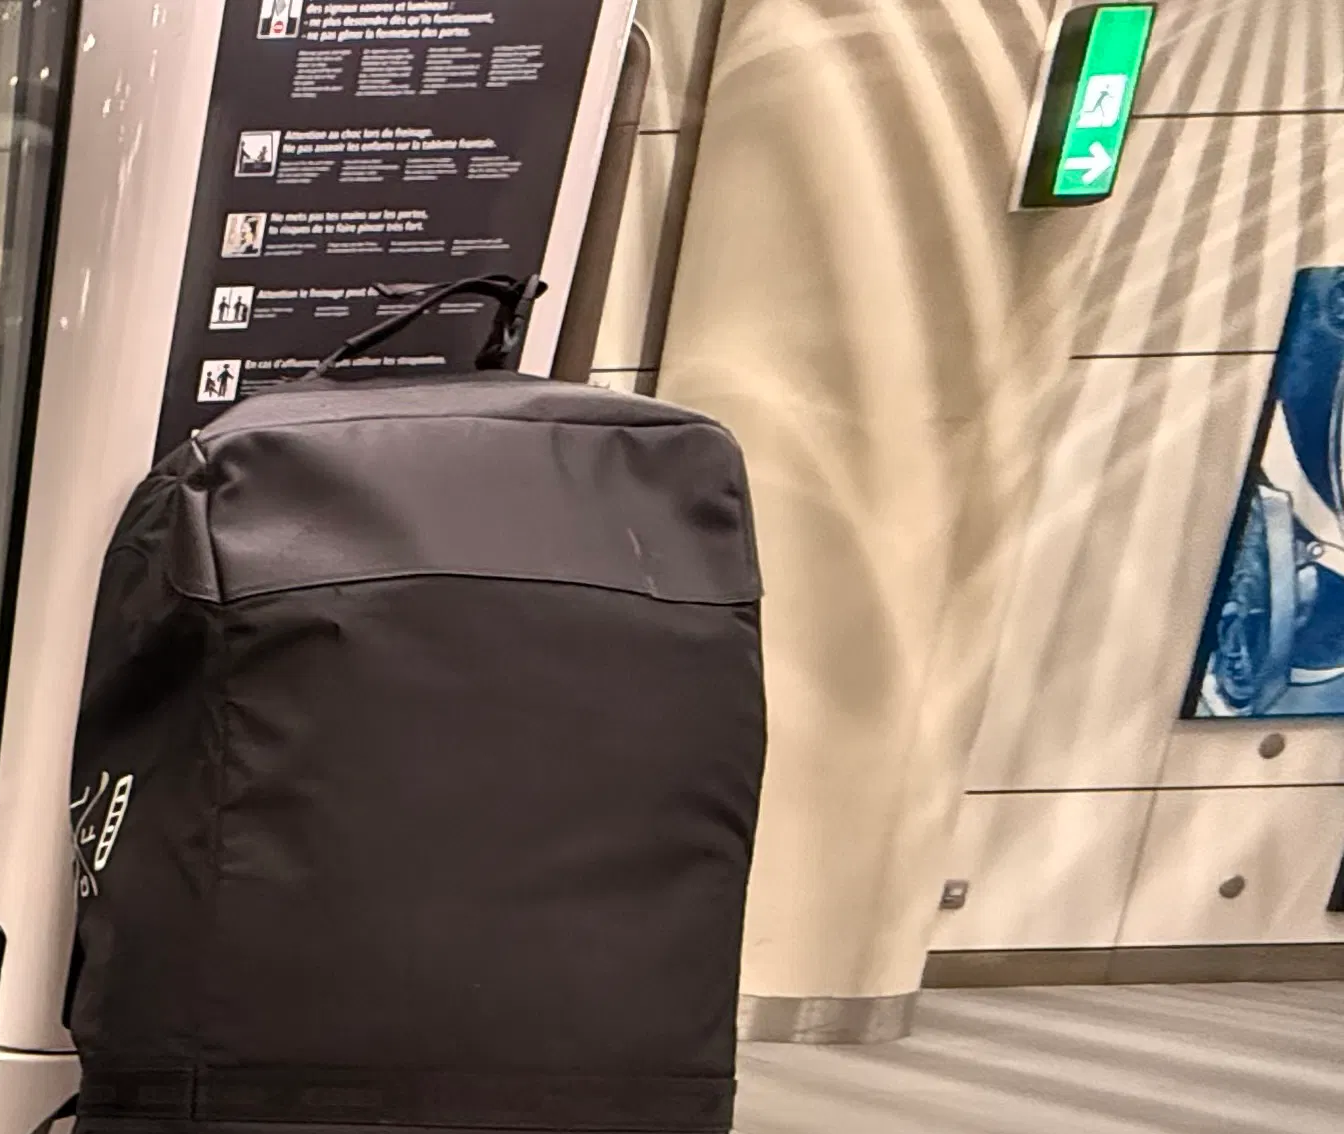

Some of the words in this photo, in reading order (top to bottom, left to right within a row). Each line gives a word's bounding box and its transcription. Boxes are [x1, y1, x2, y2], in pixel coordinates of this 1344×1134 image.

[306, 4, 322, 14] des
[324, 4, 358, 15] signaux
[359, 3, 394, 13] sonores
[395, 2, 406, 12] et
[407, 1, 448, 11] lumineux
[309, 18, 321, 27] ne
[322, 17, 342, 29] plus
[343, 15, 388, 27] descendre
[306, 31, 319, 41] ne
[320, 31, 336, 42] pas
[365, 28, 375, 39] la
[375, 27, 420, 39] fermeture
[421, 27, 438, 38] des
[284, 130, 327, 140] Attention
[340, 128, 362, 140] choc
[296, 144, 314, 155] pas
[346, 141, 360, 152] les
[361, 140, 395, 151] enfants
[395, 142, 411, 151] sur
[308, 212, 325, 223] pas
[340, 211, 367, 221] mains
[367, 211, 383, 220] sur
[383, 209, 397, 220] les
[279, 224, 311, 236] risques
[356, 223, 385, 235] pincer
[256, 289, 298, 299] Attention
[245, 360, 257, 369] En
[258, 361, 271, 369] cas
[383, 356, 396, 366] les
